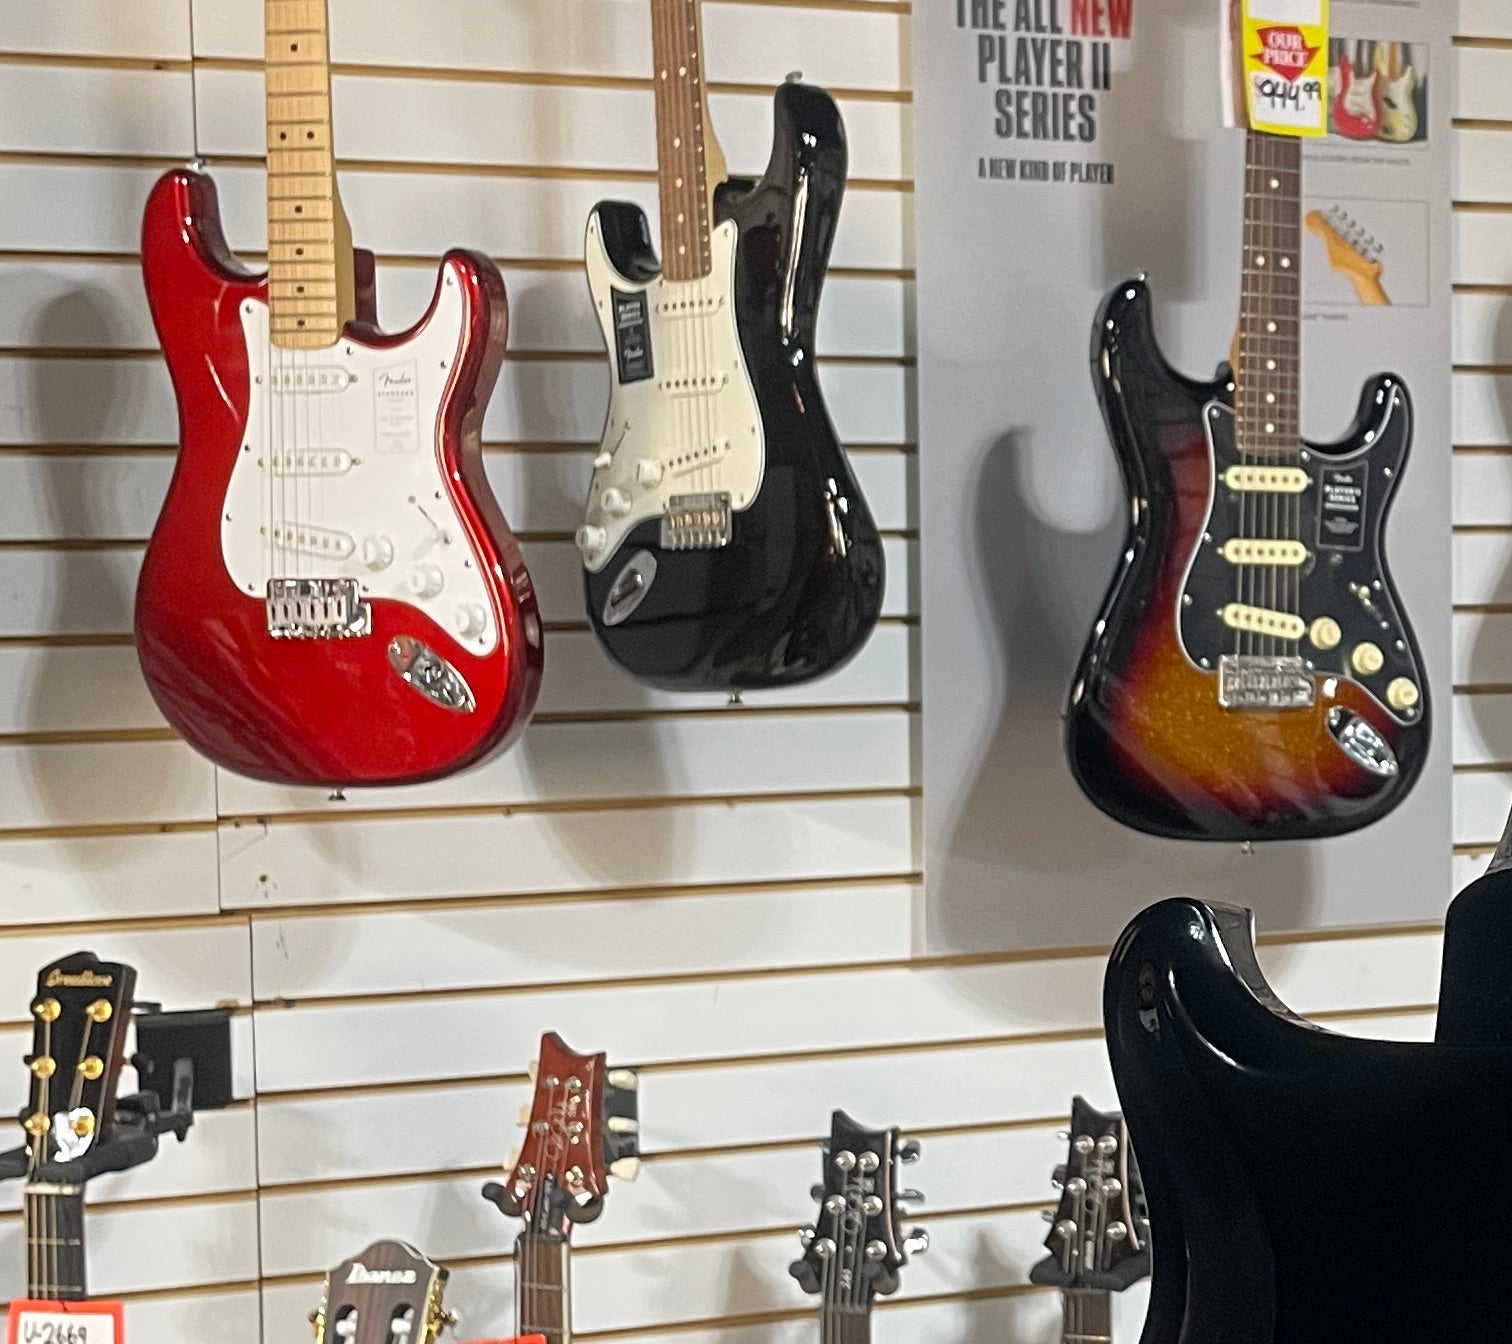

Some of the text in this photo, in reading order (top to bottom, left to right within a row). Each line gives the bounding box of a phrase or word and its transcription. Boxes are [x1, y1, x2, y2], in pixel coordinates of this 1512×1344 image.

[1267, 30, 1304, 51] OUR
[977, 33, 1111, 91] PLAYER II
[1263, 47, 1310, 67] PRICE
[994, 87, 1097, 143] SERIES
[977, 157, 1115, 185] A NEW KIND OF PLAYER
